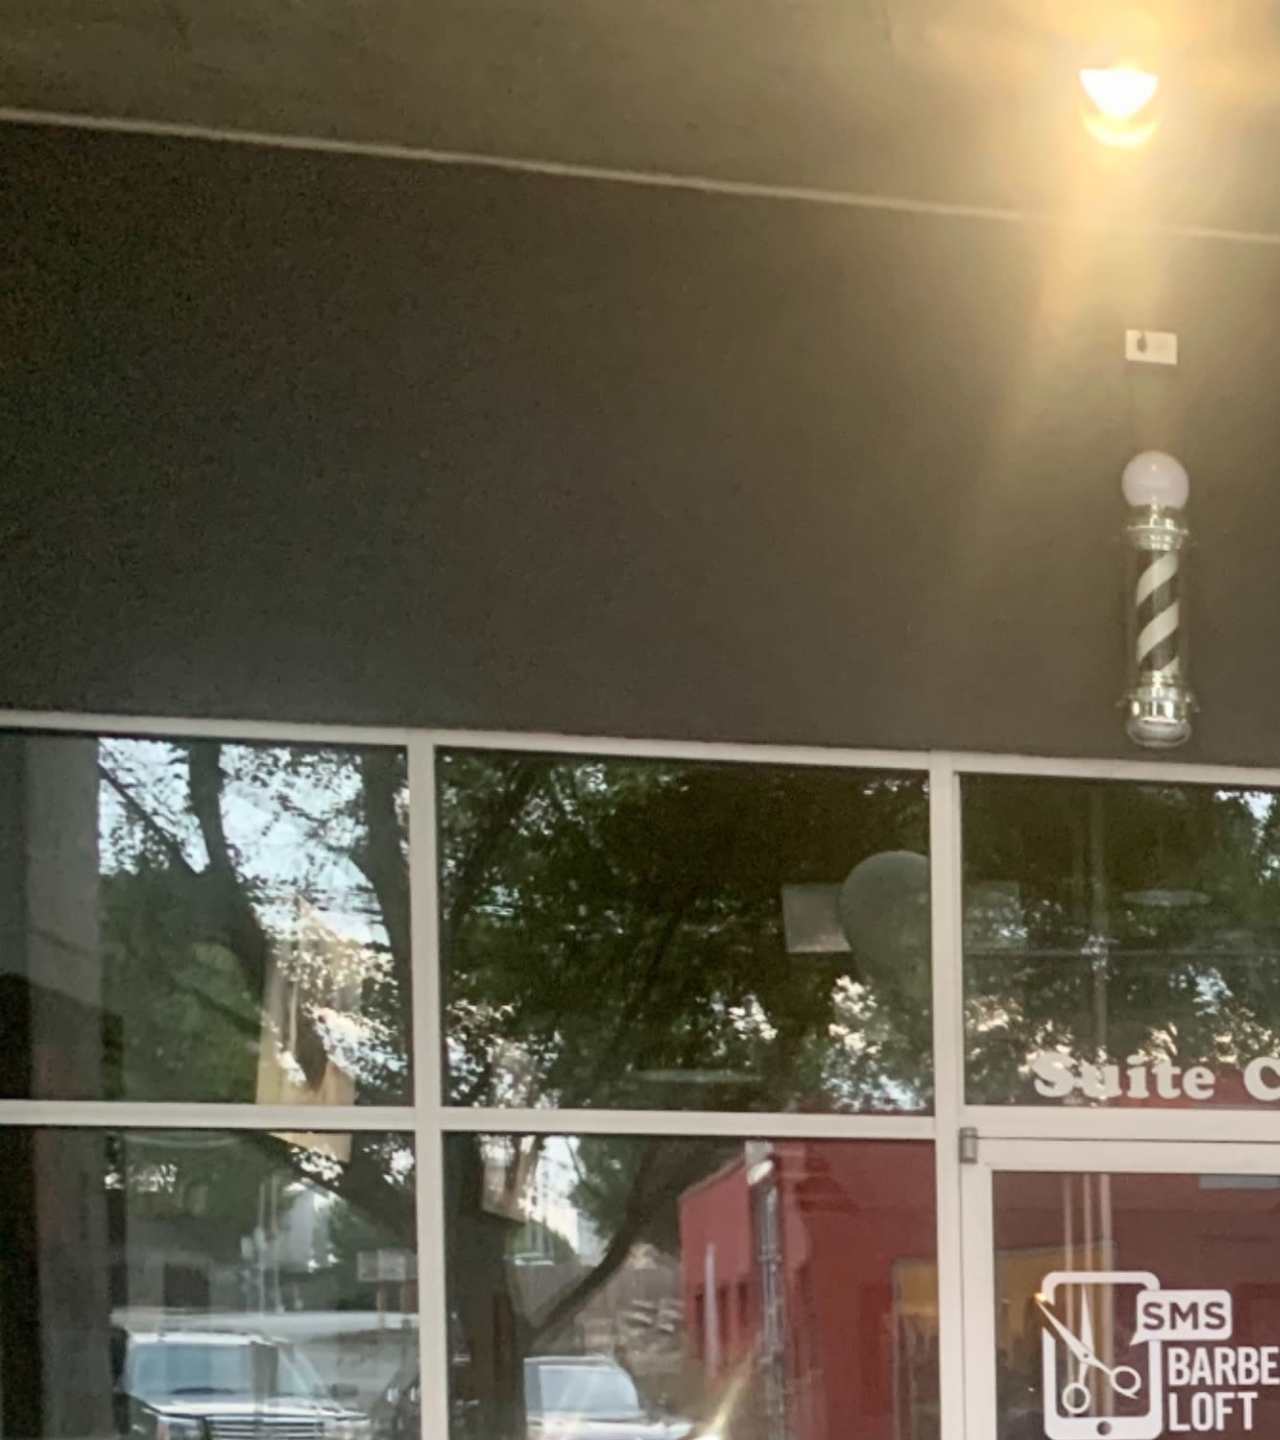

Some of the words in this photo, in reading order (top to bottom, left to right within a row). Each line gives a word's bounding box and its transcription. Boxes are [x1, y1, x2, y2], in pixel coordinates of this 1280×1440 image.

[1031, 1050, 1216, 1099] Suite
[1142, 1302, 1227, 1331] SMS
[1168, 1392, 1259, 1432] LOFT
